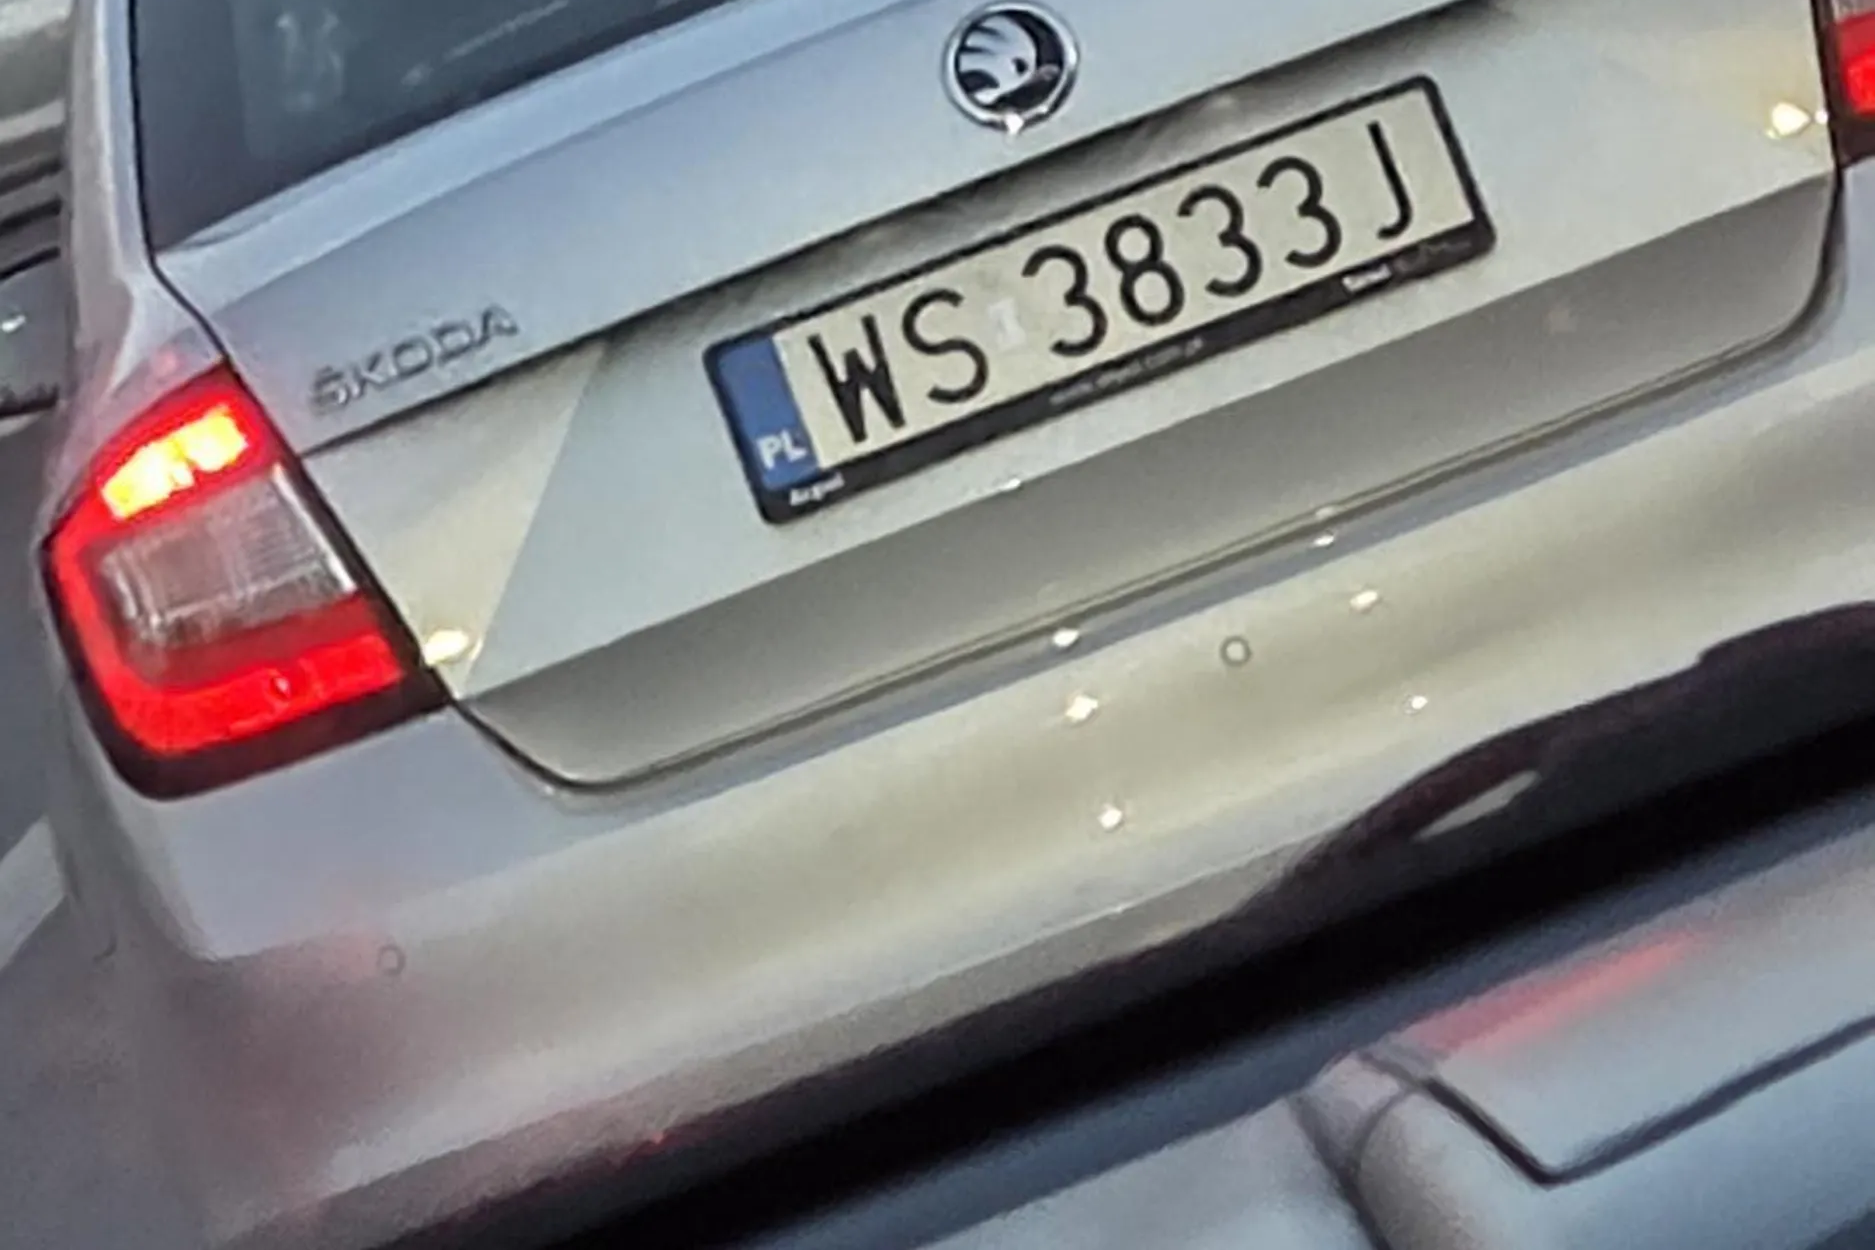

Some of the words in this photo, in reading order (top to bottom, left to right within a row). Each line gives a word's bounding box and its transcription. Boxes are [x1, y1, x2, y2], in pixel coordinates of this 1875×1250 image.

[809, 287, 989, 442] WS
[1020, 121, 1414, 354] 3833J
[757, 428, 808, 469] PL
